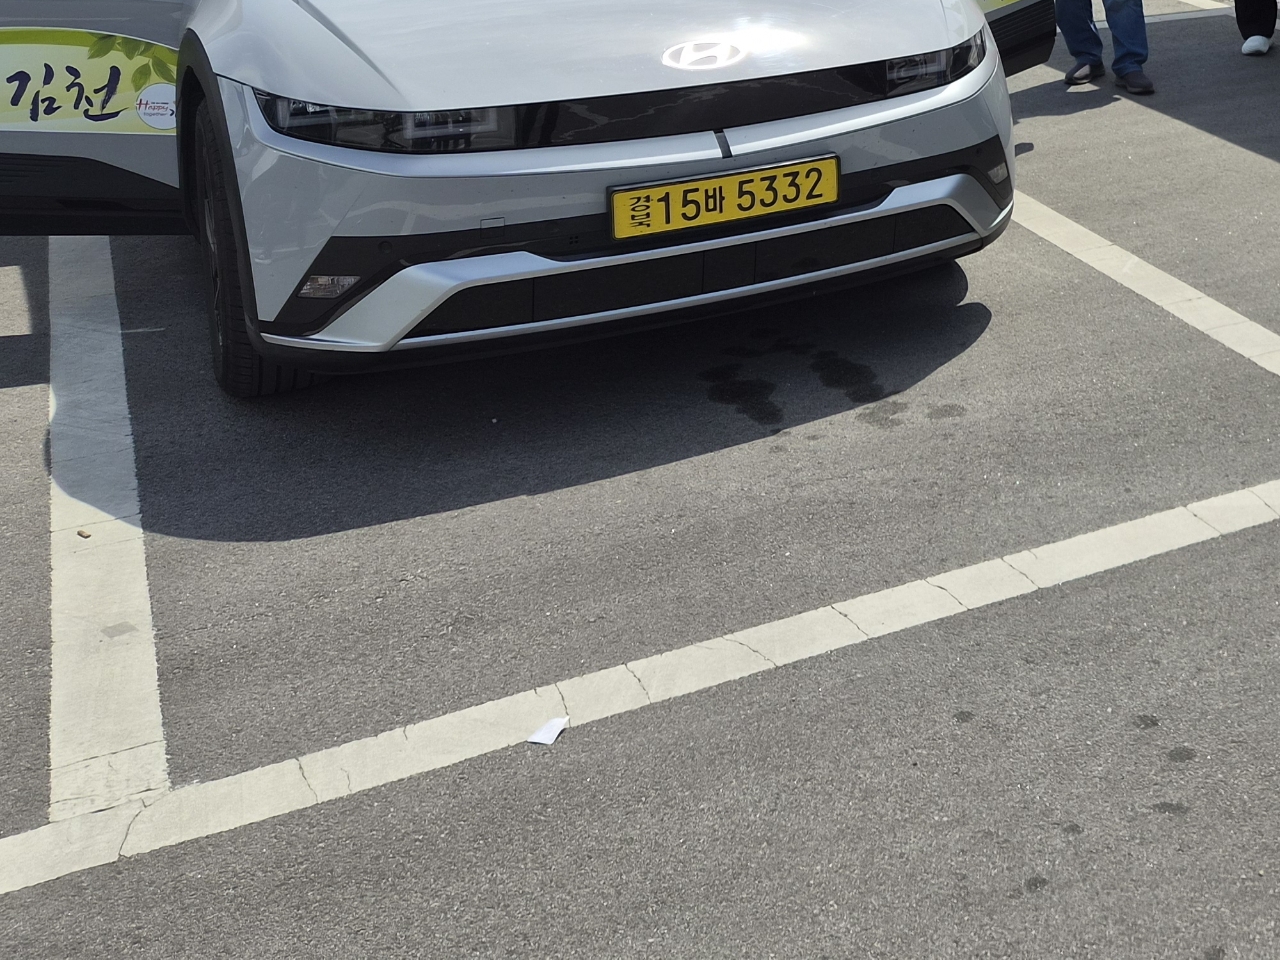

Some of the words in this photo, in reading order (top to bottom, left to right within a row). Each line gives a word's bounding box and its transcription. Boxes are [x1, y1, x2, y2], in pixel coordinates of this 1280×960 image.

[6, 62, 129, 122] 김천
[629, 194, 652, 228] 경북
[656, 185, 726, 225] 15바
[736, 167, 824, 212] 5332
